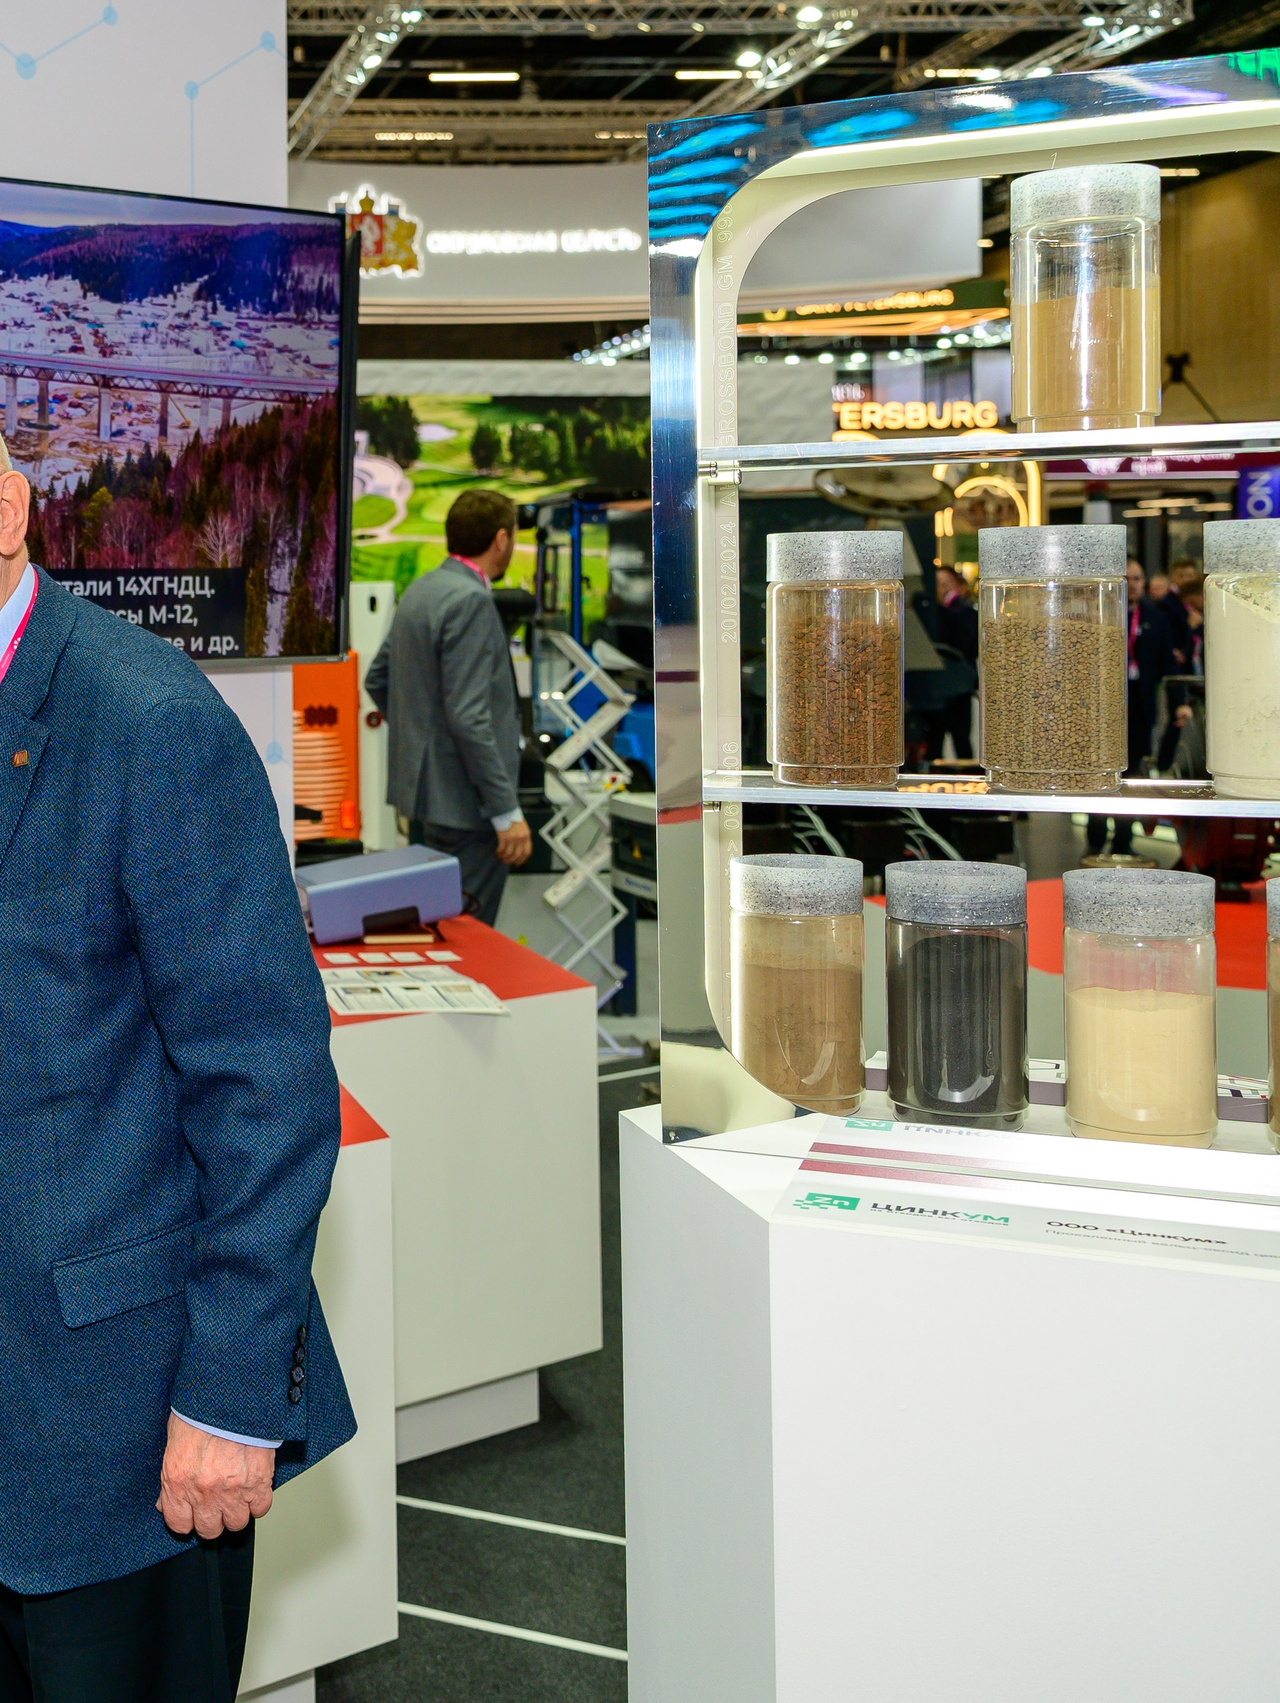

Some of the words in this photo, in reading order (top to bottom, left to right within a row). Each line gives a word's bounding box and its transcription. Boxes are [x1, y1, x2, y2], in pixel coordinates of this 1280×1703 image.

[832, 400, 999, 431] ERSBURG
[56, 580, 112, 598] тали
[116, 576, 216, 599] 14ХГНДЦ.
[149, 605, 199, 627] М-12,
[190, 637, 204, 652] и
[208, 635, 240, 656] др.
[871, 1202, 1010, 1224] ЦИНКУМ
[1046, 1220, 1099, 1231] ООО
